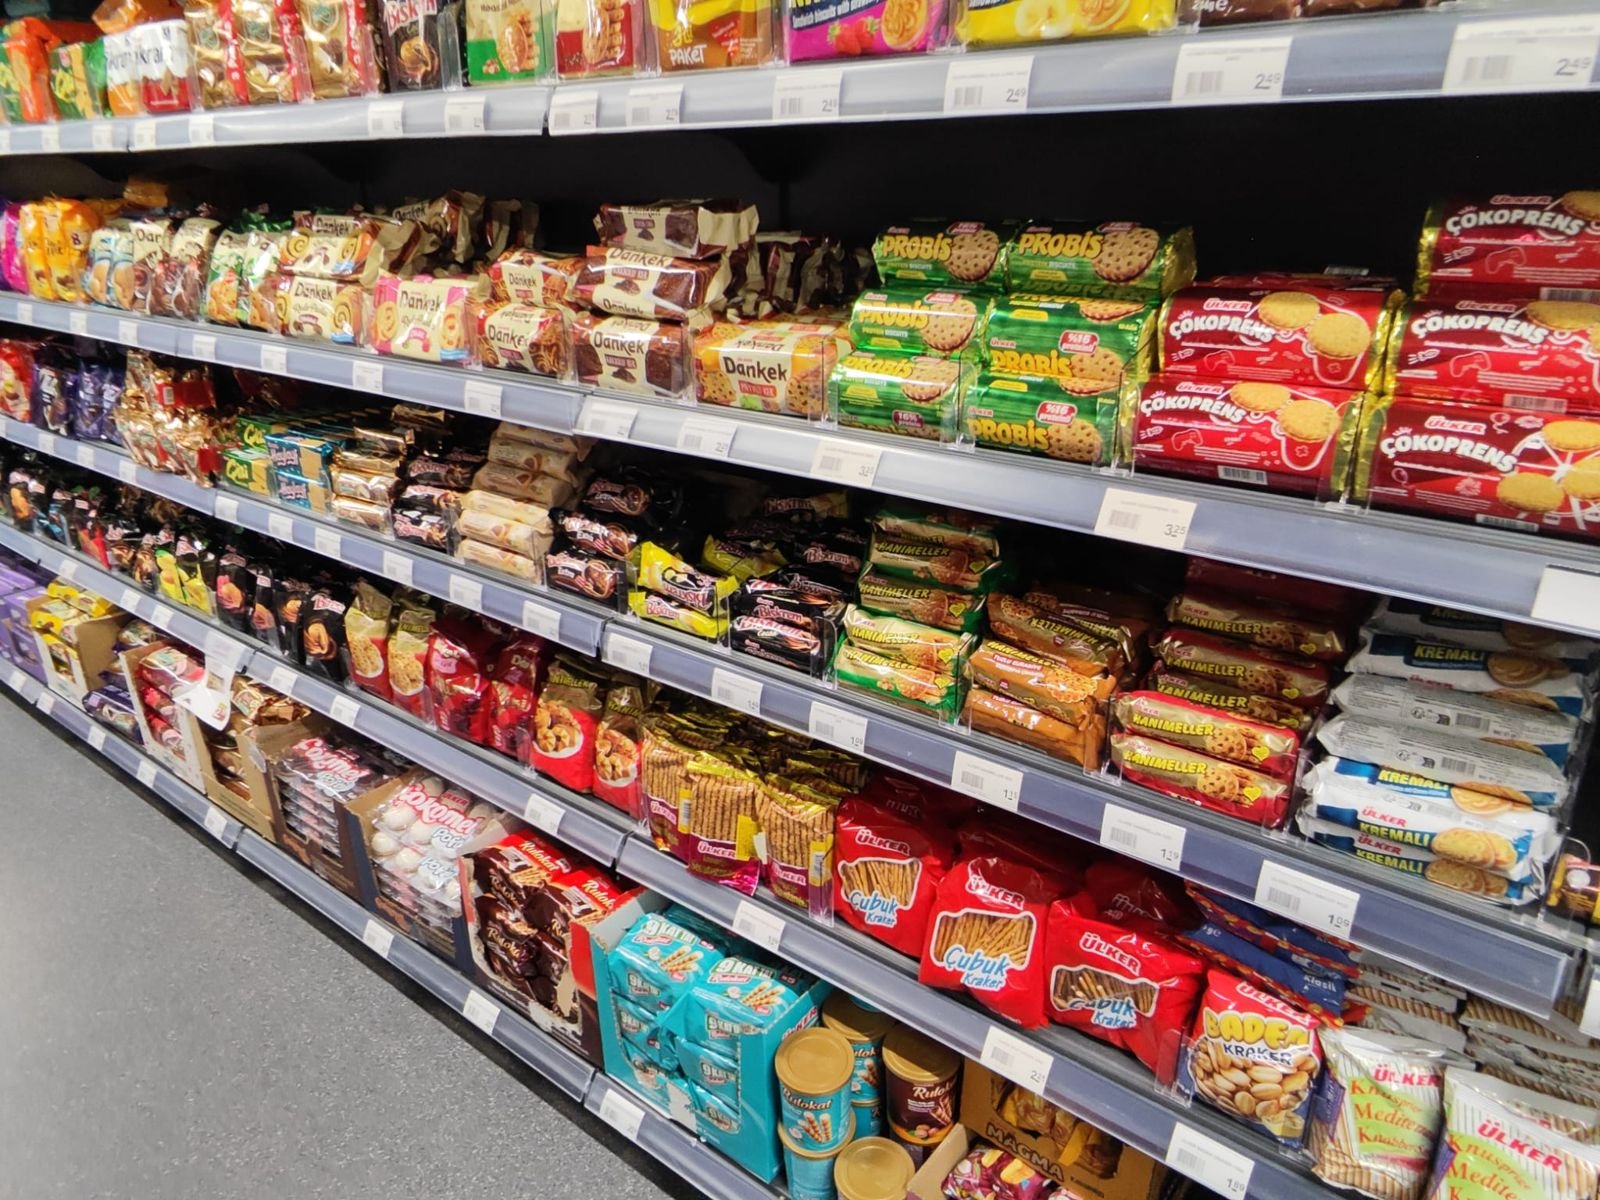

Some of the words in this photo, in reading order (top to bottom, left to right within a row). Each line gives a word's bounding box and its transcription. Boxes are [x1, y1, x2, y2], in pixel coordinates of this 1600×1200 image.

[1446, 209, 1585, 236] ÇOKOPRENS
[610, 247, 666, 267] Dankek
[294, 282, 333, 301] Dankek
[508, 272, 537, 289] Dankek
[1204, 299, 1251, 311] ÜLKER
[1170, 315, 1275, 343] ÇOKOPRENS
[1411, 315, 1549, 344] ÇOKOPRENS
[594, 331, 646, 355] Dankek
[723, 356, 787, 383] Dankek
[1140, 396, 1247, 423] ÇOKOPRENS
[1425, 416, 1486, 434] ÜLKER
[1380, 435, 1518, 473] ÇOKOPRENS
[1163, 523, 1187, 538] 325
[878, 542, 950, 556] HANIMELLER
[860, 583, 930, 598] HANIMELLER
[757, 605, 802, 623] Biskrem
[1183, 615, 1261, 634] HANIMELLER
[1413, 644, 1484, 661] KREMALI
[1133, 713, 1214, 736] HANIMELLER
[1124, 750, 1207, 774] HANIMELLER
[1361, 806, 1407, 827] ÜLKER
[856, 828, 910, 856] ÜLKER
[1358, 835, 1402, 855] ÜLKER
[1360, 822, 1430, 846] KREMALI
[697, 841, 736, 859] ÜLKER
[1356, 849, 1423, 874] KREMALI
[582, 879, 614, 910] Rulok
[851, 890, 897, 915] Çubuk
[965, 875, 1024, 910] ÜLKER
[865, 912, 897, 928] Kraker
[1328, 914, 1350, 928] 109
[945, 947, 1009, 978] Çubuk
[1080, 932, 1141, 975] ÜLKER
[962, 973, 1005, 989] Kraker
[1092, 1010, 1136, 1027] Kraker
[1205, 1009, 1311, 1050] BADEM
[783, 1089, 832, 1110] Rulokat
[1477, 1120, 1563, 1172] ÜLKER
